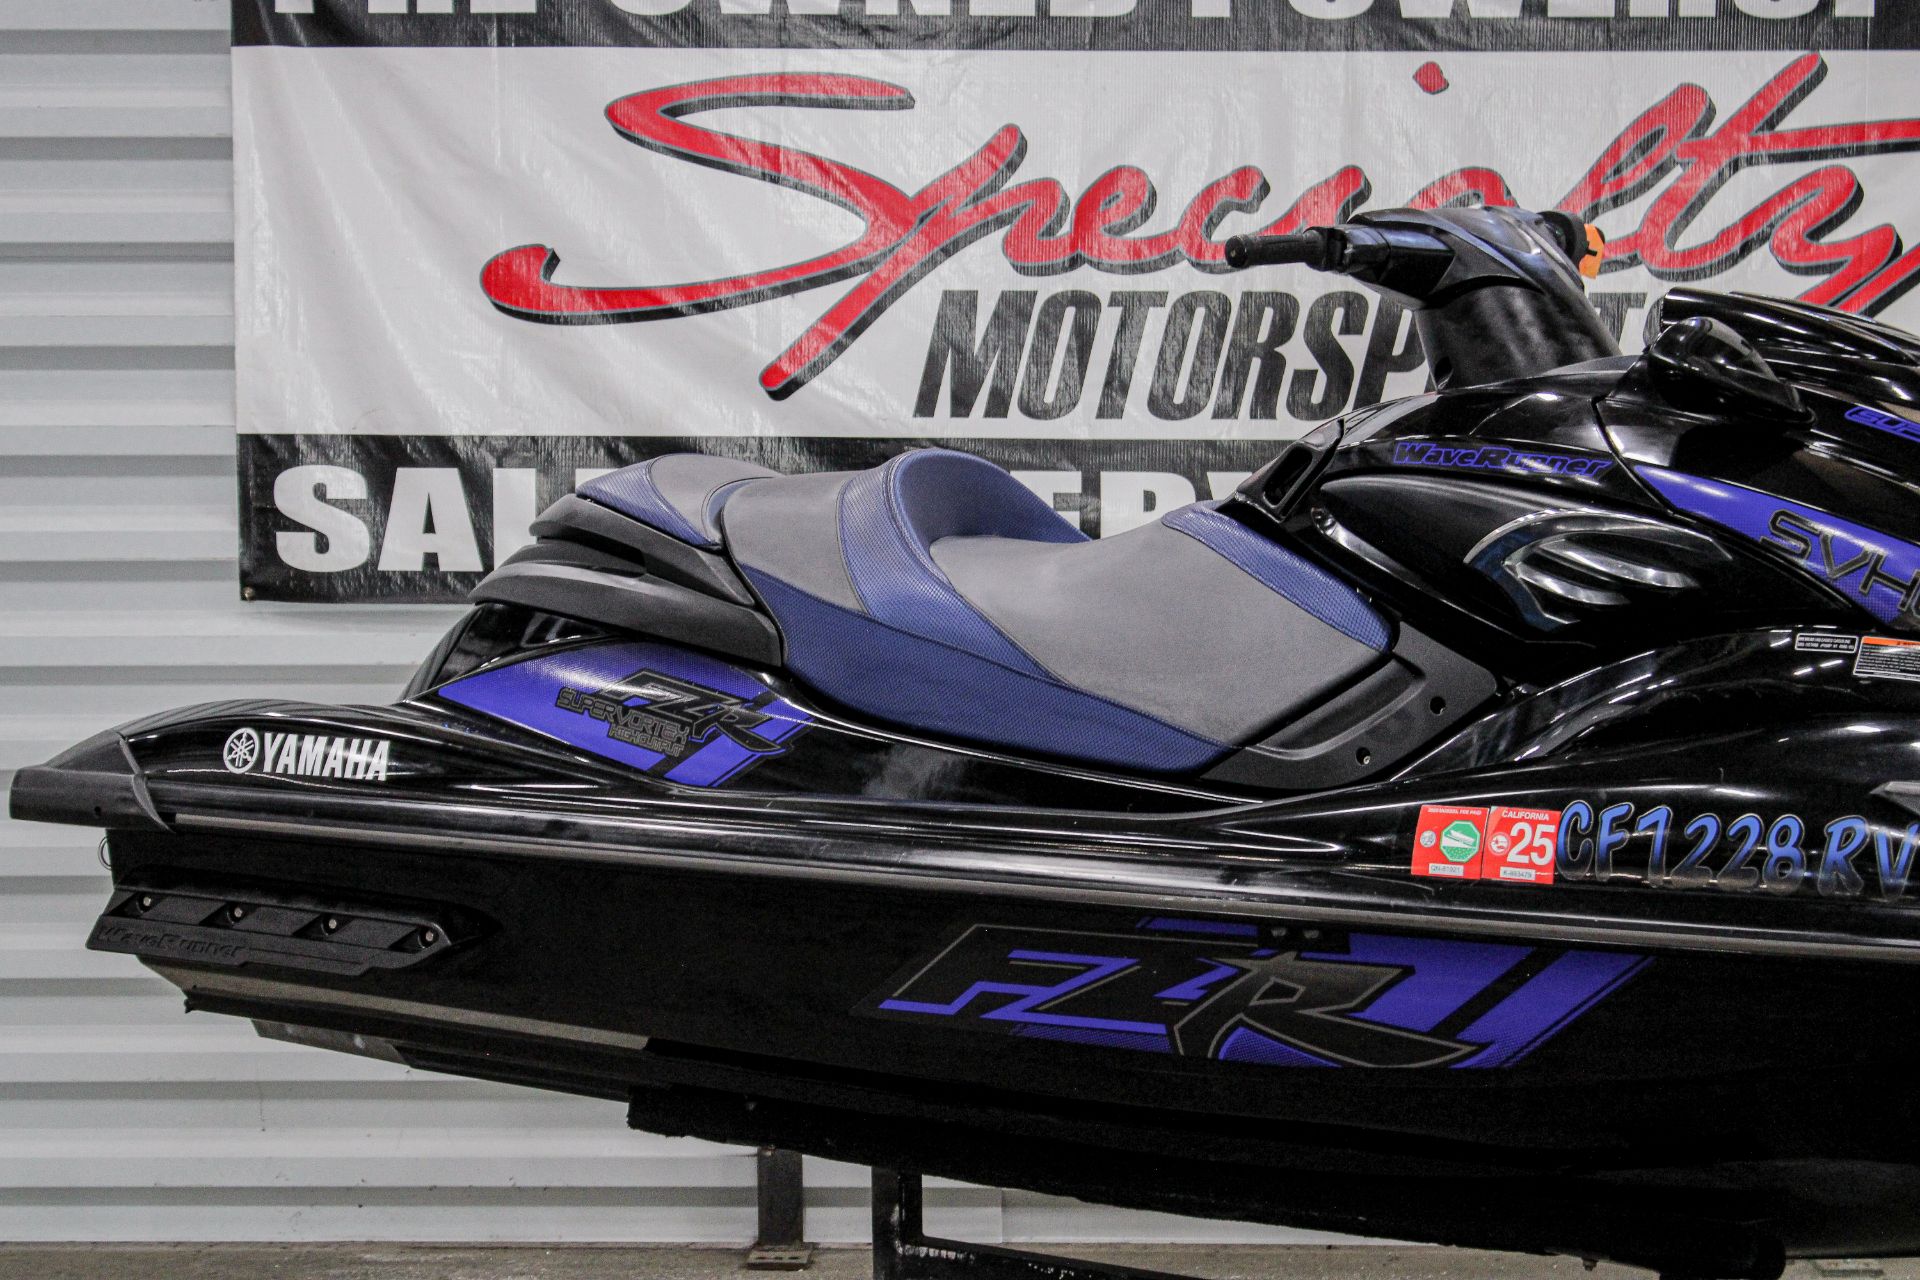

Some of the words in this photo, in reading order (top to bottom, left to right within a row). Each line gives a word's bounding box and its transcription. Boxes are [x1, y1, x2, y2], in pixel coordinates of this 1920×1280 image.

[1393, 442, 1612, 478] WaveRunner
[263, 732, 390, 781] YAMAHA
[1502, 809, 1550, 821] CALIFORNIA
[1507, 821, 1556, 866] 25
[1817, 815, 1920, 899] RV
